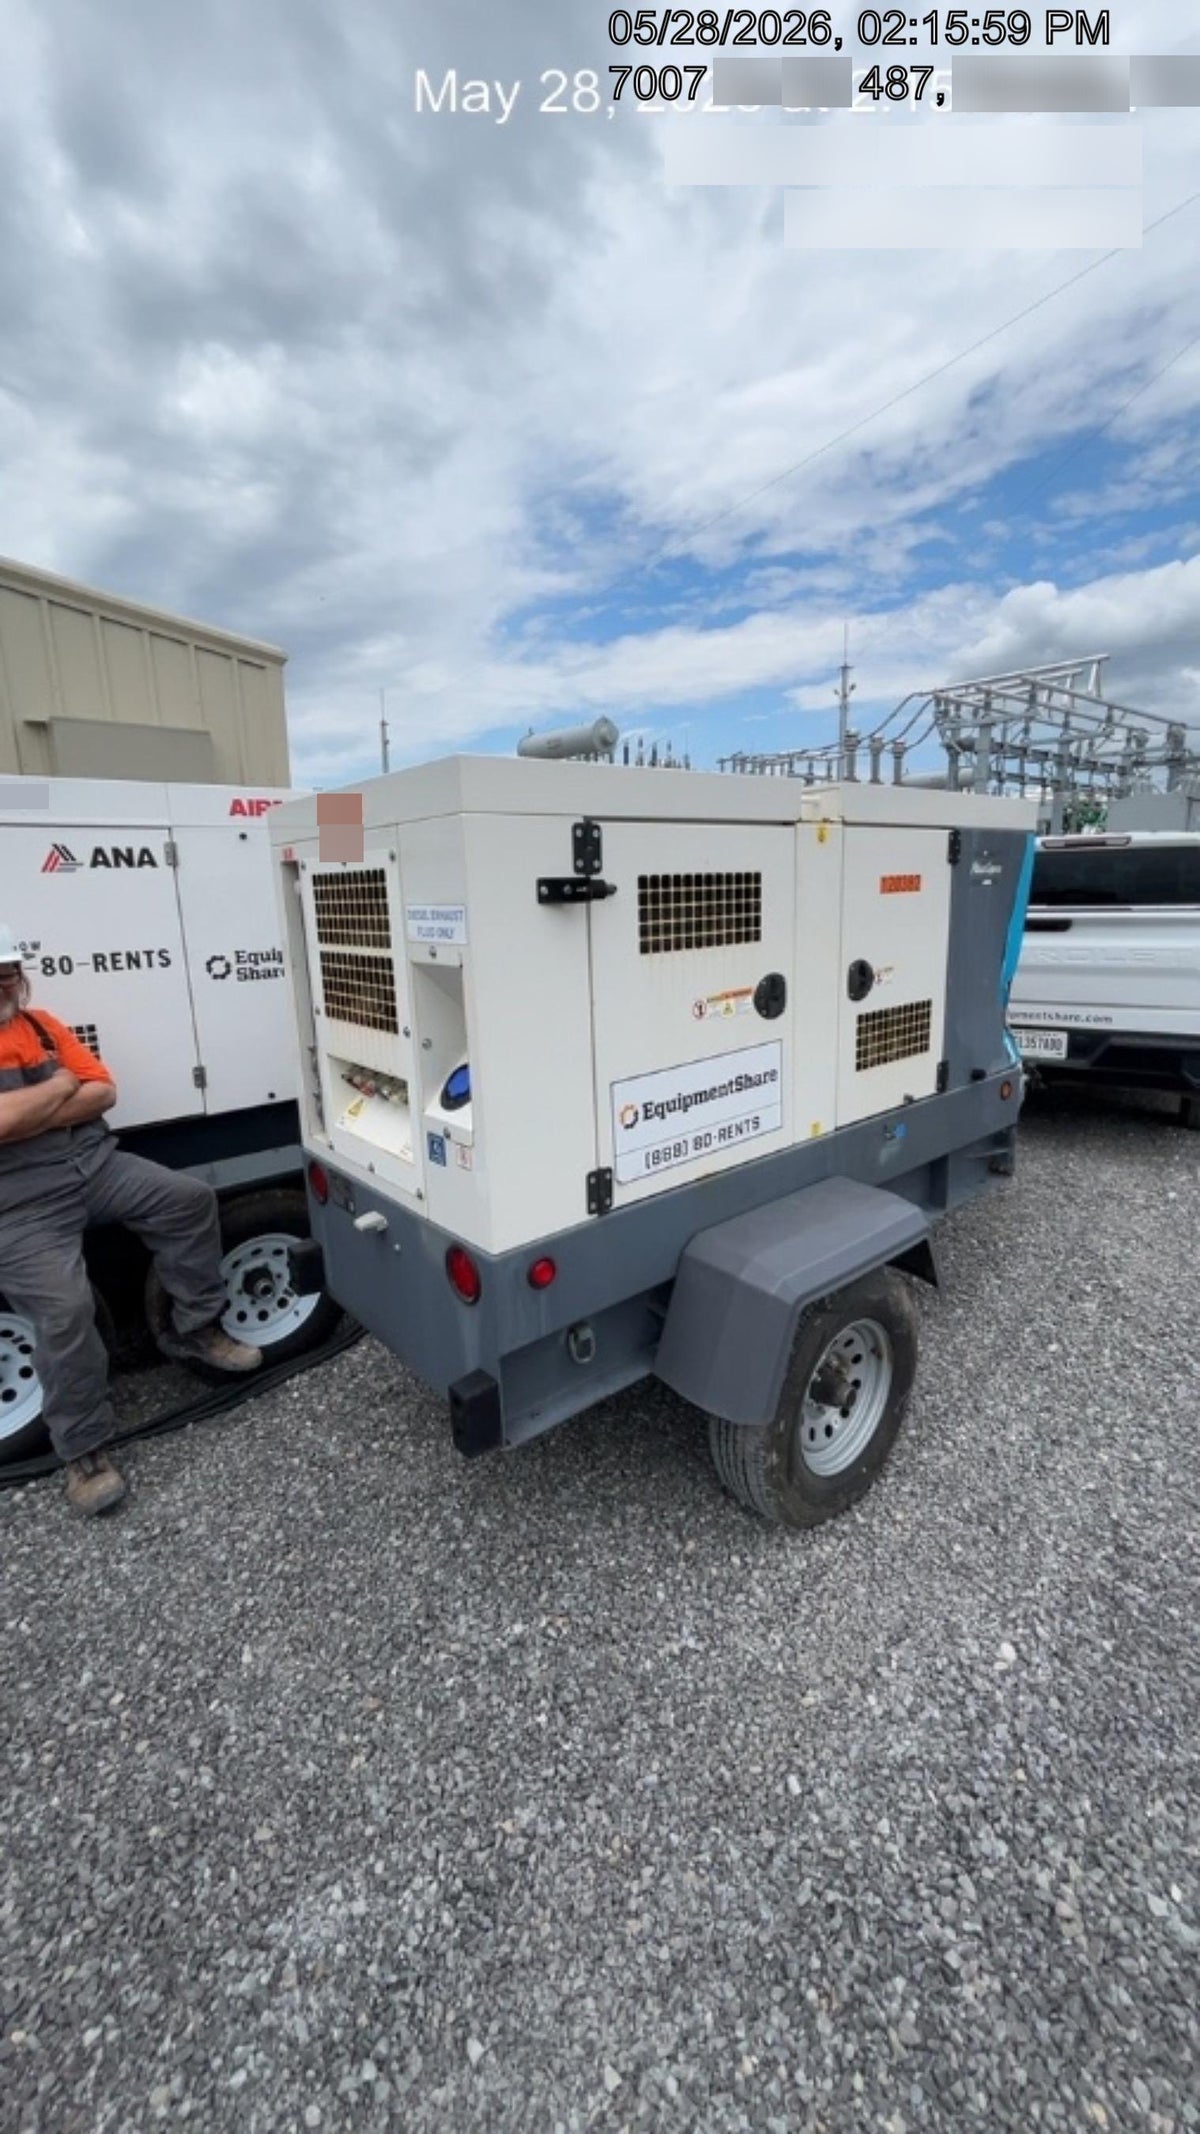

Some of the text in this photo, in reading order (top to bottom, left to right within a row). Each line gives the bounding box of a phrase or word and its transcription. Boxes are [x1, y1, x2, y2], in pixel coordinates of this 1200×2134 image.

[229, 798, 283, 817] AIR
[90, 846, 158, 868] ANA
[24, 949, 172, 977] -80-RENTS
[642, 1068, 778, 1121] EquipmentShare
[645, 1139, 689, 1169] (888)
